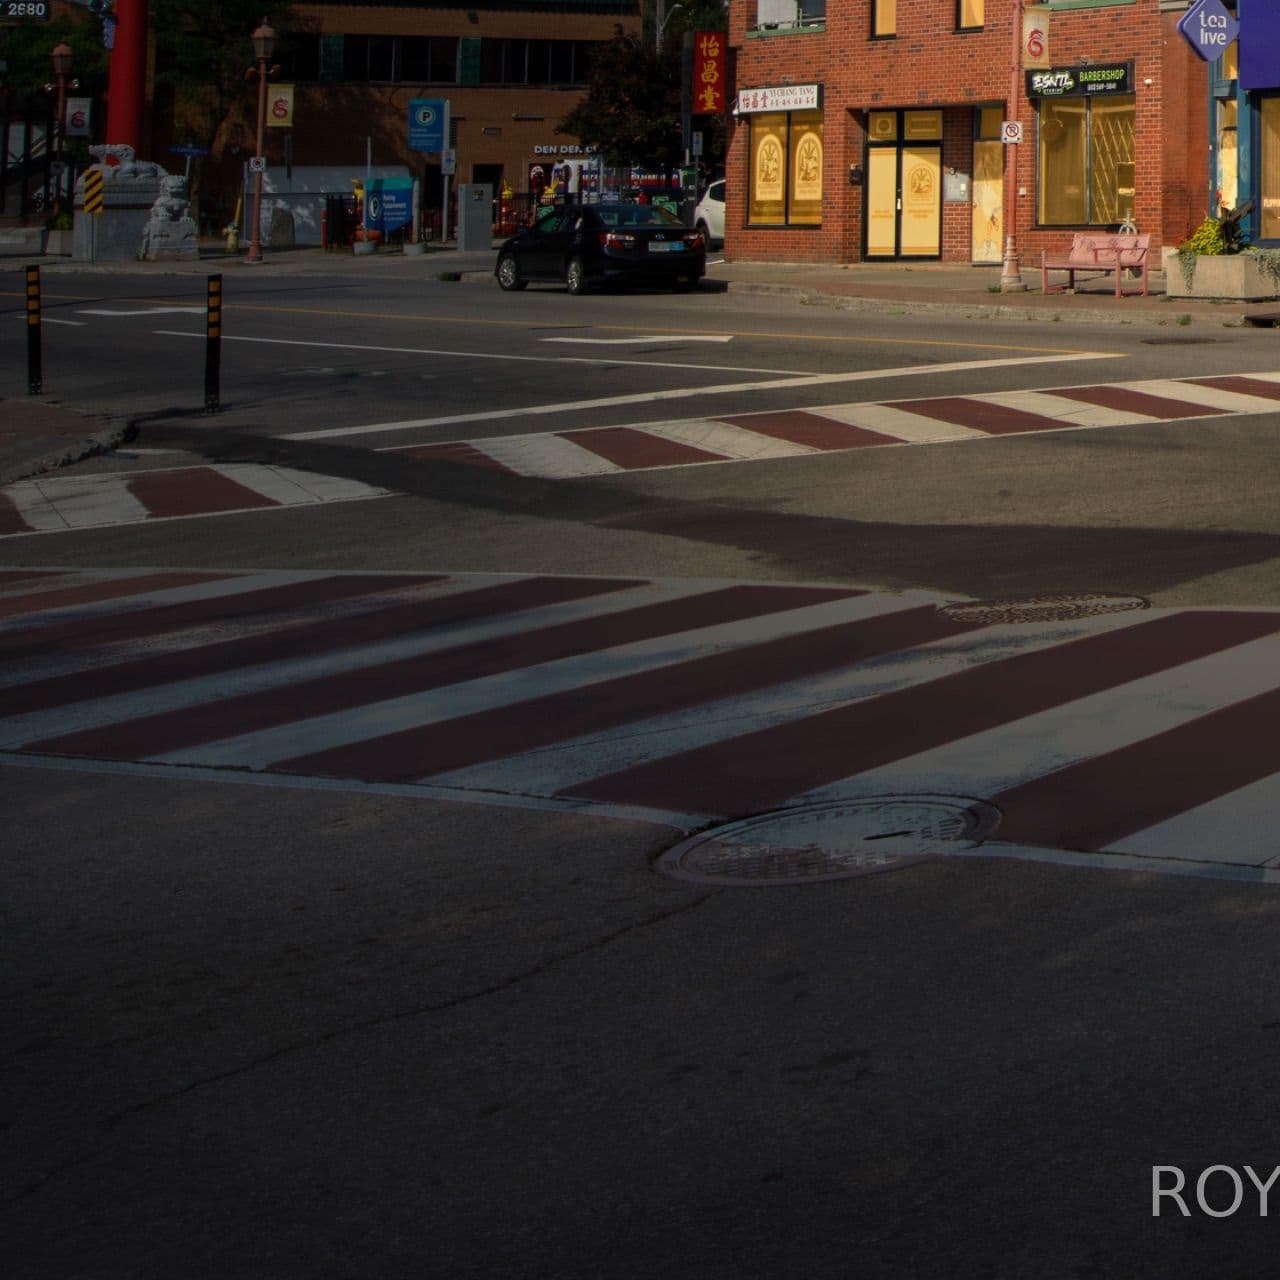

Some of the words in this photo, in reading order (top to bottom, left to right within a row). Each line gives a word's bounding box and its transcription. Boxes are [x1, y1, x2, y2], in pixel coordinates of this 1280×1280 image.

[1199, 10, 1227, 28] tea
[1200, 28, 1227, 46] live
[699, 35, 721, 111] 怡昌堂
[1079, 69, 1125, 82] BARBERSHOP
